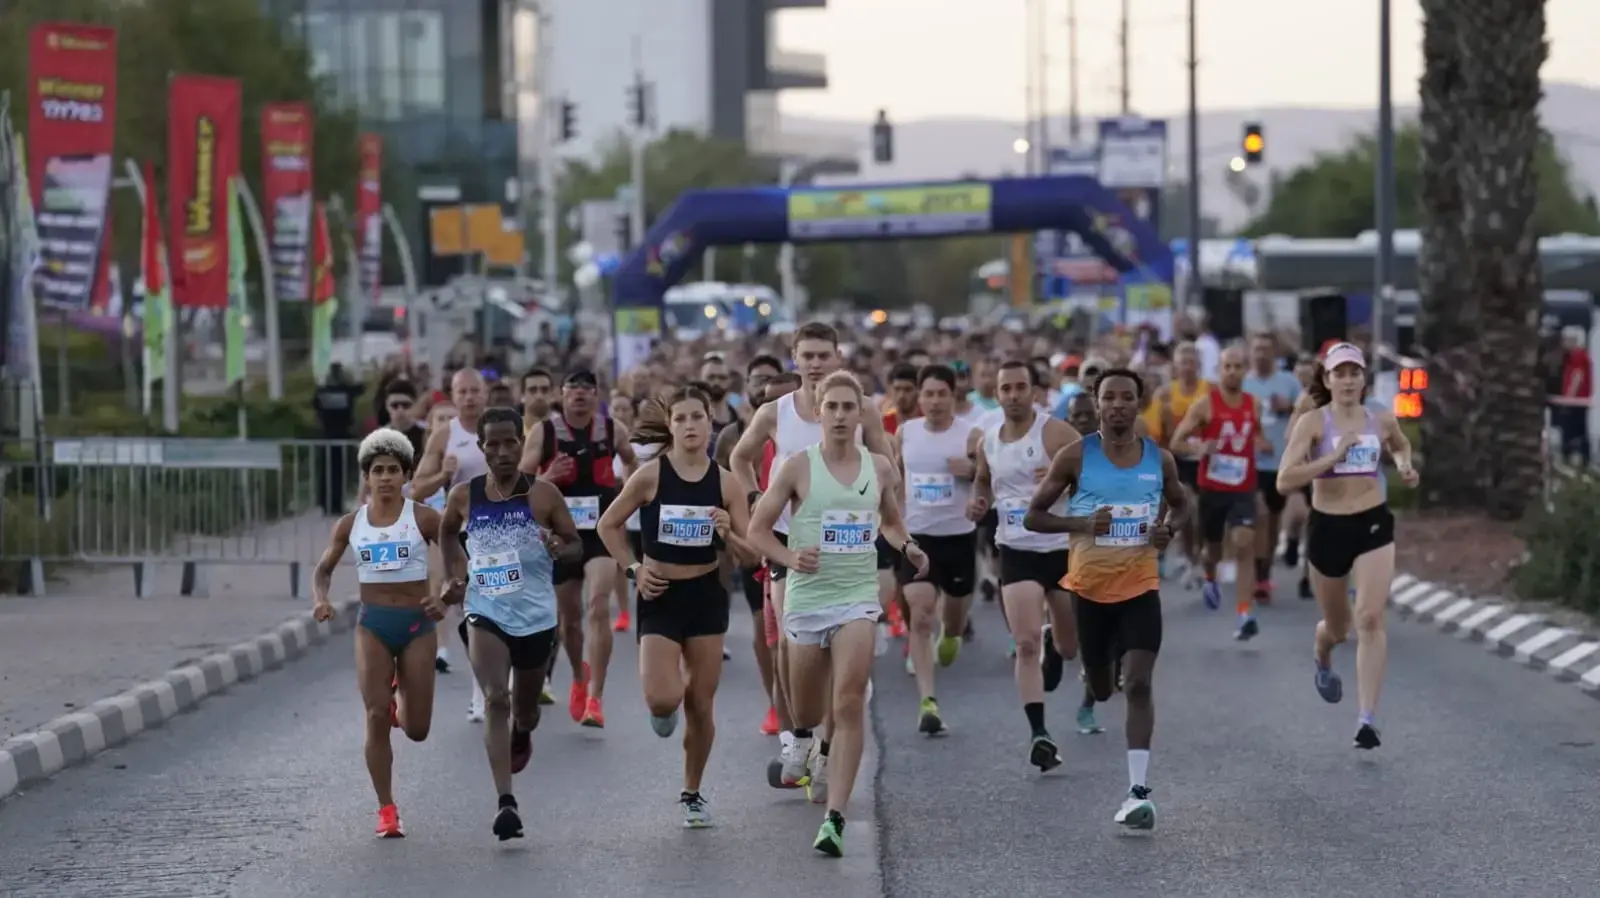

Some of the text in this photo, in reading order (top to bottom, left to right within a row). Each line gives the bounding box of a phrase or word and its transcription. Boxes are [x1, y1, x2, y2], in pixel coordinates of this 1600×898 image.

[675, 523, 699, 537] 1507
[837, 529, 862, 544] 1389
[1112, 523, 1137, 537] 1007
[379, 547, 389, 561] 2
[485, 570, 507, 586] 1298
